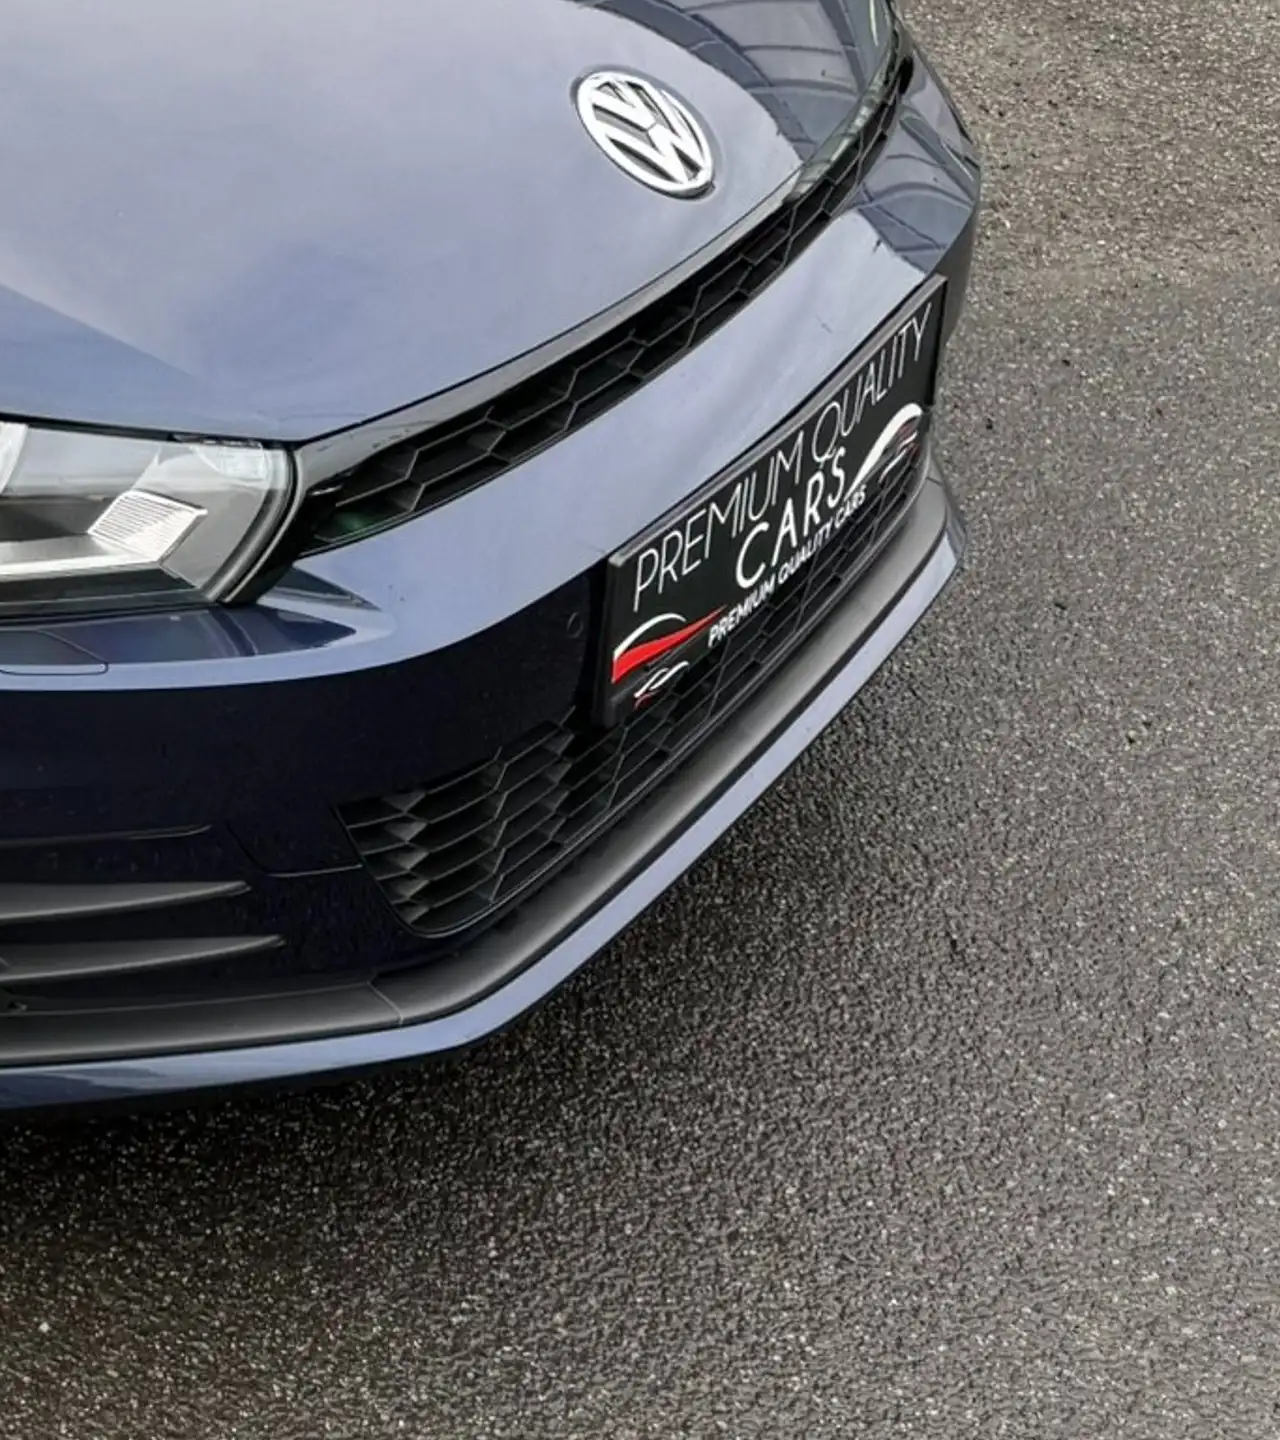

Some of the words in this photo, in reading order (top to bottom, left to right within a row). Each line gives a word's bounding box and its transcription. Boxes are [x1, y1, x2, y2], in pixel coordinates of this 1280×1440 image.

[632, 428, 804, 613] PREMIUM
[812, 302, 932, 468] QUALITY
[735, 445, 846, 589] CARS
[707, 573, 777, 649] PREMIUM
[778, 516, 835, 584] QUALITY
[834, 483, 868, 529] CARS
